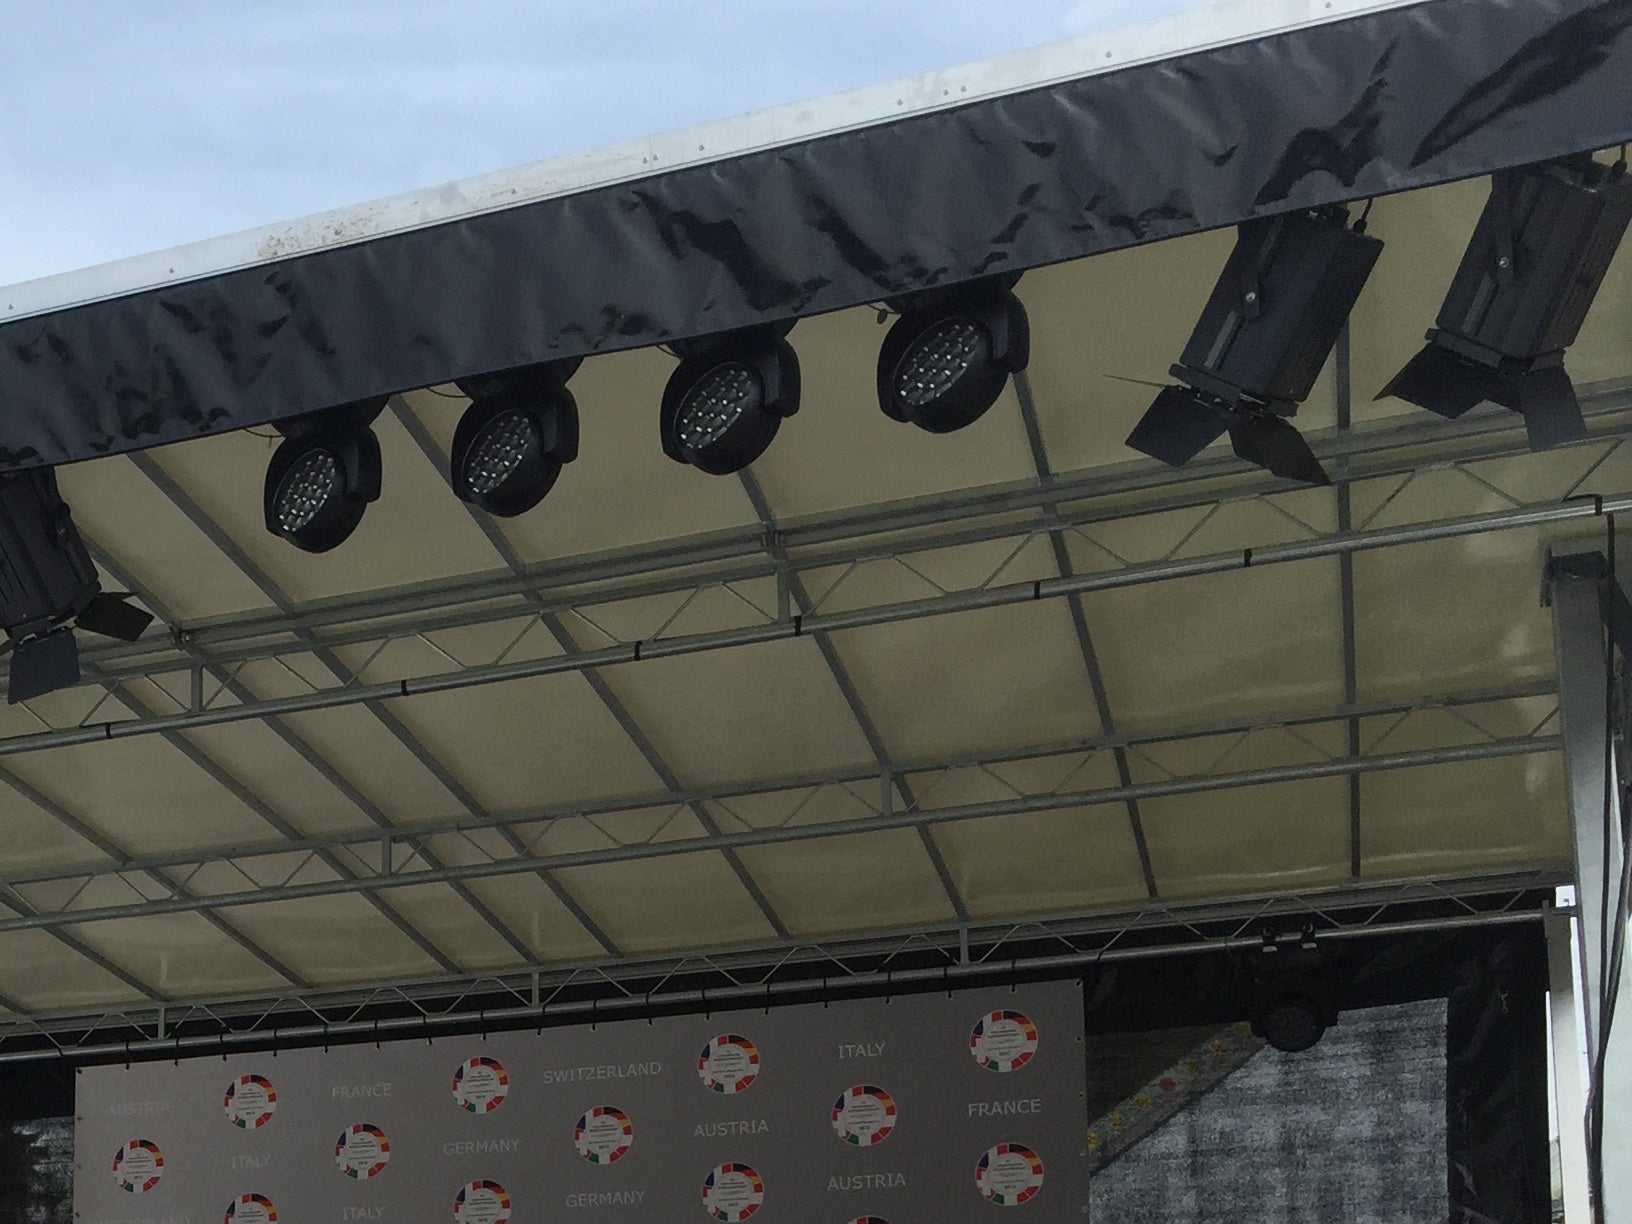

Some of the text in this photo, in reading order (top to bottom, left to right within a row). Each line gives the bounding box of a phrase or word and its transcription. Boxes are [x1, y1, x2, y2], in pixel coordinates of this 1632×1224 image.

[838, 1042, 886, 1058] ITALY
[543, 1062, 662, 1084] SWITZERLAND
[332, 1083, 392, 1098] FRANCE
[968, 1099, 1041, 1118] FRANCE
[694, 1120, 768, 1138] AUSTRIA
[443, 1138, 520, 1156] GERMANY
[232, 1154, 270, 1169] ITALY
[828, 1174, 906, 1191] AUSTRIA
[566, 1190, 644, 1208] GERMANY
[343, 1206, 384, 1220] ITALY
